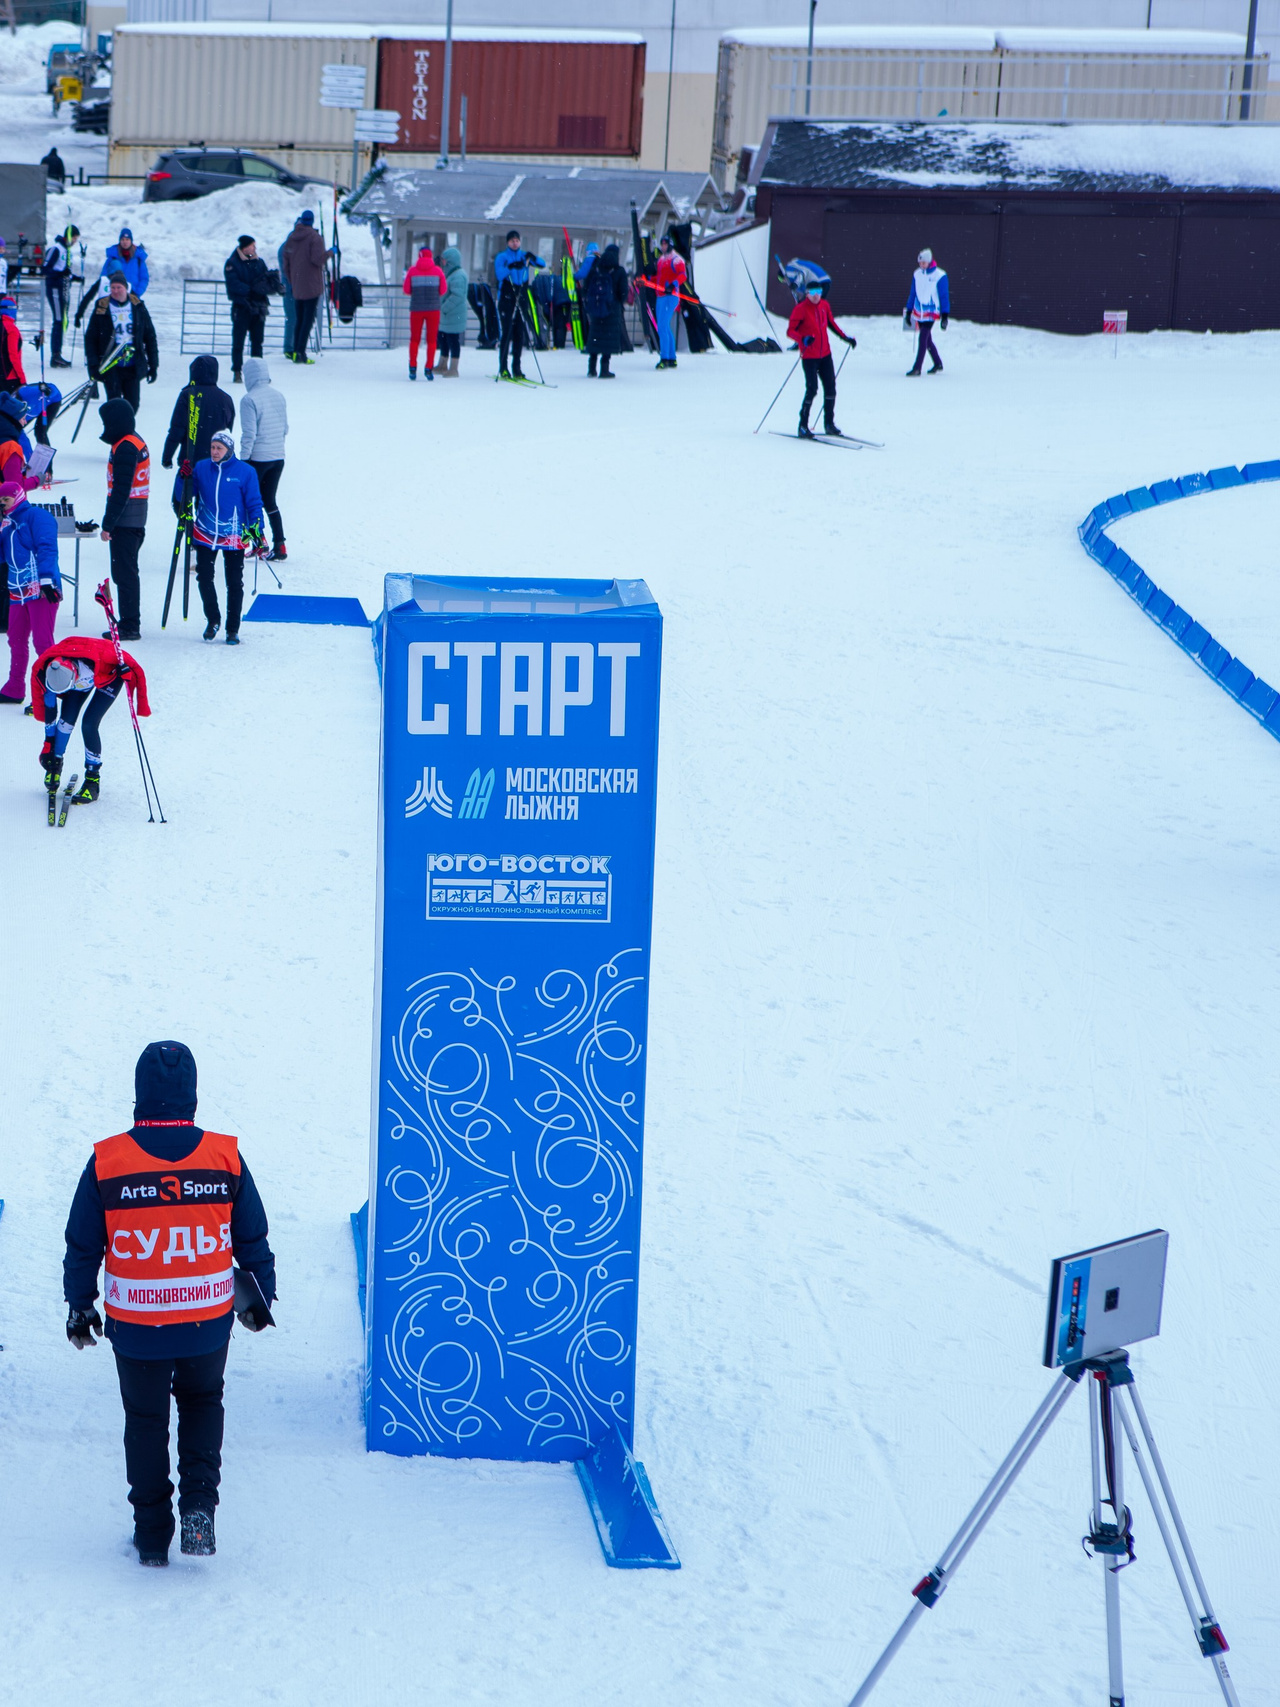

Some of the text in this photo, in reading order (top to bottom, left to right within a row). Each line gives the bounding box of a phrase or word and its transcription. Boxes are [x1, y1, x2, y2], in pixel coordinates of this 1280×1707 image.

[411, 49, 430, 121] TRITON
[407, 642, 641, 737] СТАРТ
[506, 767, 638, 793] МОСКОВСКАЯ
[504, 795, 579, 821] ЛЫЖНЯ
[428, 854, 610, 875] ЮГО-ВОСТОК
[431, 905, 474, 913] ОКРУЖНОЙ
[475, 906, 560, 915] БИАТЛОННО-ЛЫЖНЫЙ
[121, 1180, 228, 1200] Arta Sport
[111, 1222, 233, 1264] СУДЬЯ
[128, 1281, 210, 1304] МОСКОВСКИЙ
